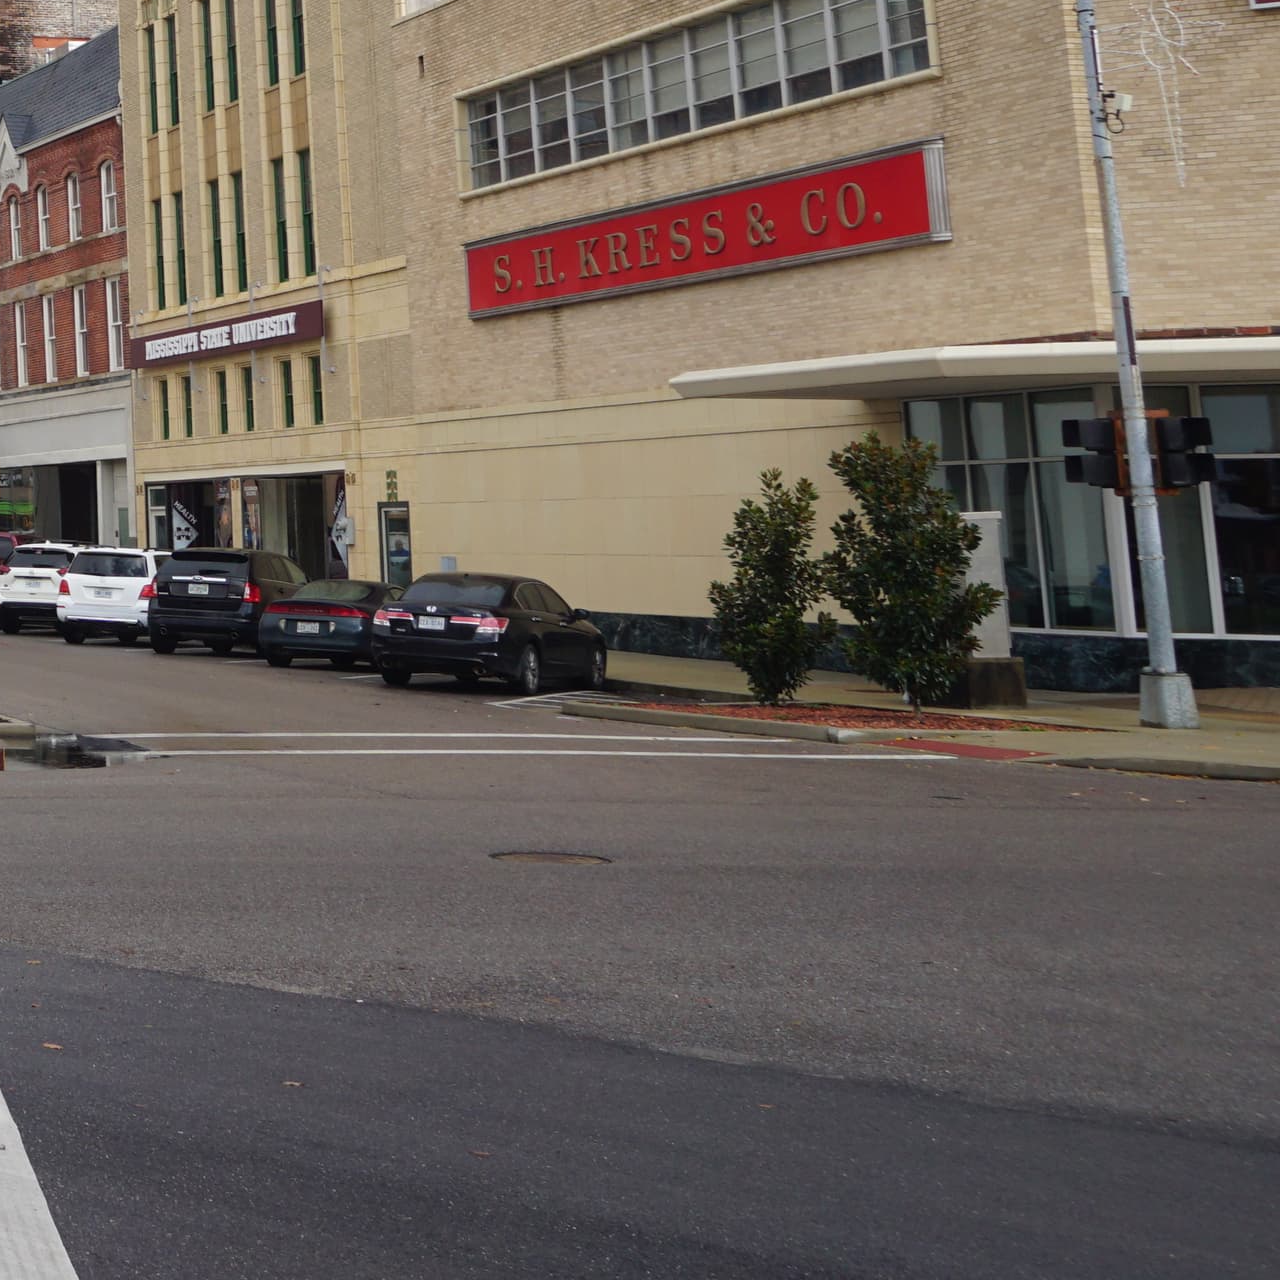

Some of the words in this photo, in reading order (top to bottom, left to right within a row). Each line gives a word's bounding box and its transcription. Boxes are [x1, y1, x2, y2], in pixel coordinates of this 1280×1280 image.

[493, 254, 523, 294] S.
[531, 246, 566, 287] H.
[576, 209, 727, 280] KRESS
[745, 201, 776, 248] &
[799, 181, 884, 237] CO.
[145, 332, 199, 361] MISSISSIPPI
[200, 325, 231, 351] STATE
[232, 312, 297, 345] UNIVERSITY
[173, 499, 197, 525] HEALTH
